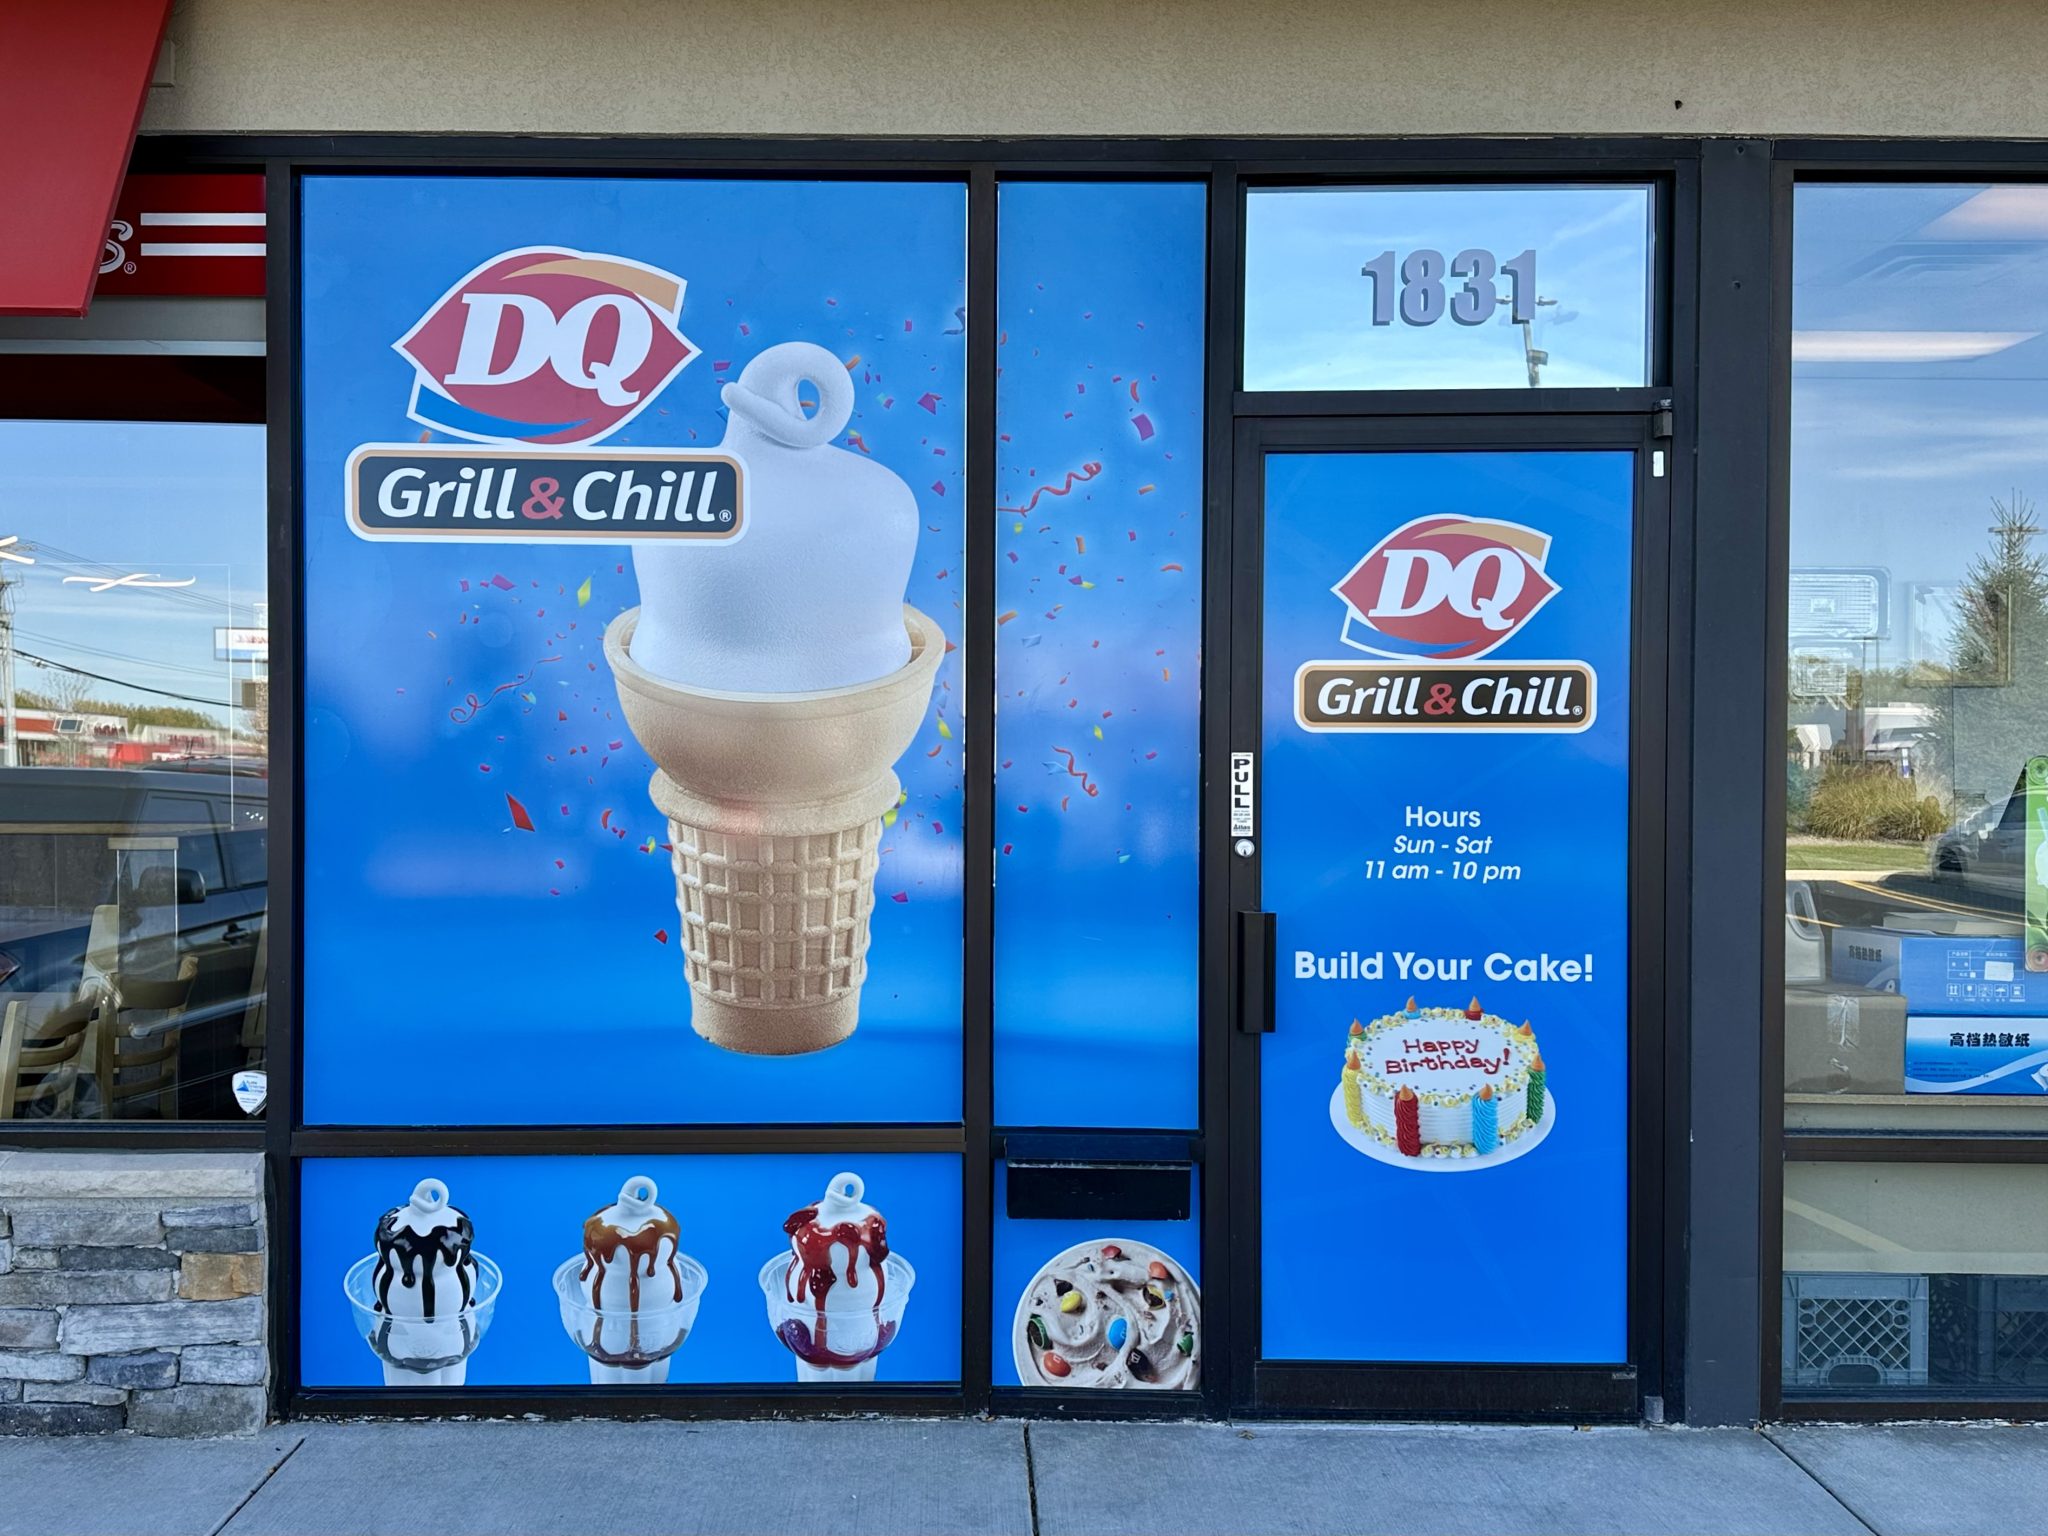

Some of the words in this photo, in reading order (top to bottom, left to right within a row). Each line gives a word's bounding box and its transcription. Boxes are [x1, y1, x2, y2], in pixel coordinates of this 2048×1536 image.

[1361, 249, 1536, 327] 1831
[443, 293, 653, 407] DQ
[378, 467, 517, 520] Grill
[1368, 547, 1525, 631] DQ
[1317, 677, 1421, 716] Grill
[1233, 758, 1250, 808] PULL
[1405, 805, 1481, 828] Hours
[1393, 835, 1435, 854] Sun
[1455, 835, 1493, 854] Sat
[1364, 860, 1386, 879] 11
[1392, 866, 1429, 880] am
[1452, 861, 1478, 880] 10
[1482, 866, 1521, 884] pm
[1295, 951, 1383, 979] Build
[1392, 952, 1472, 980] Your
[1483, 952, 1593, 982] Cake!
[1403, 1039, 1479, 1057] Happy
[1949, 1032, 2030, 1048] 高档热敏纸
[1385, 1048, 1511, 1076] Birthday!
